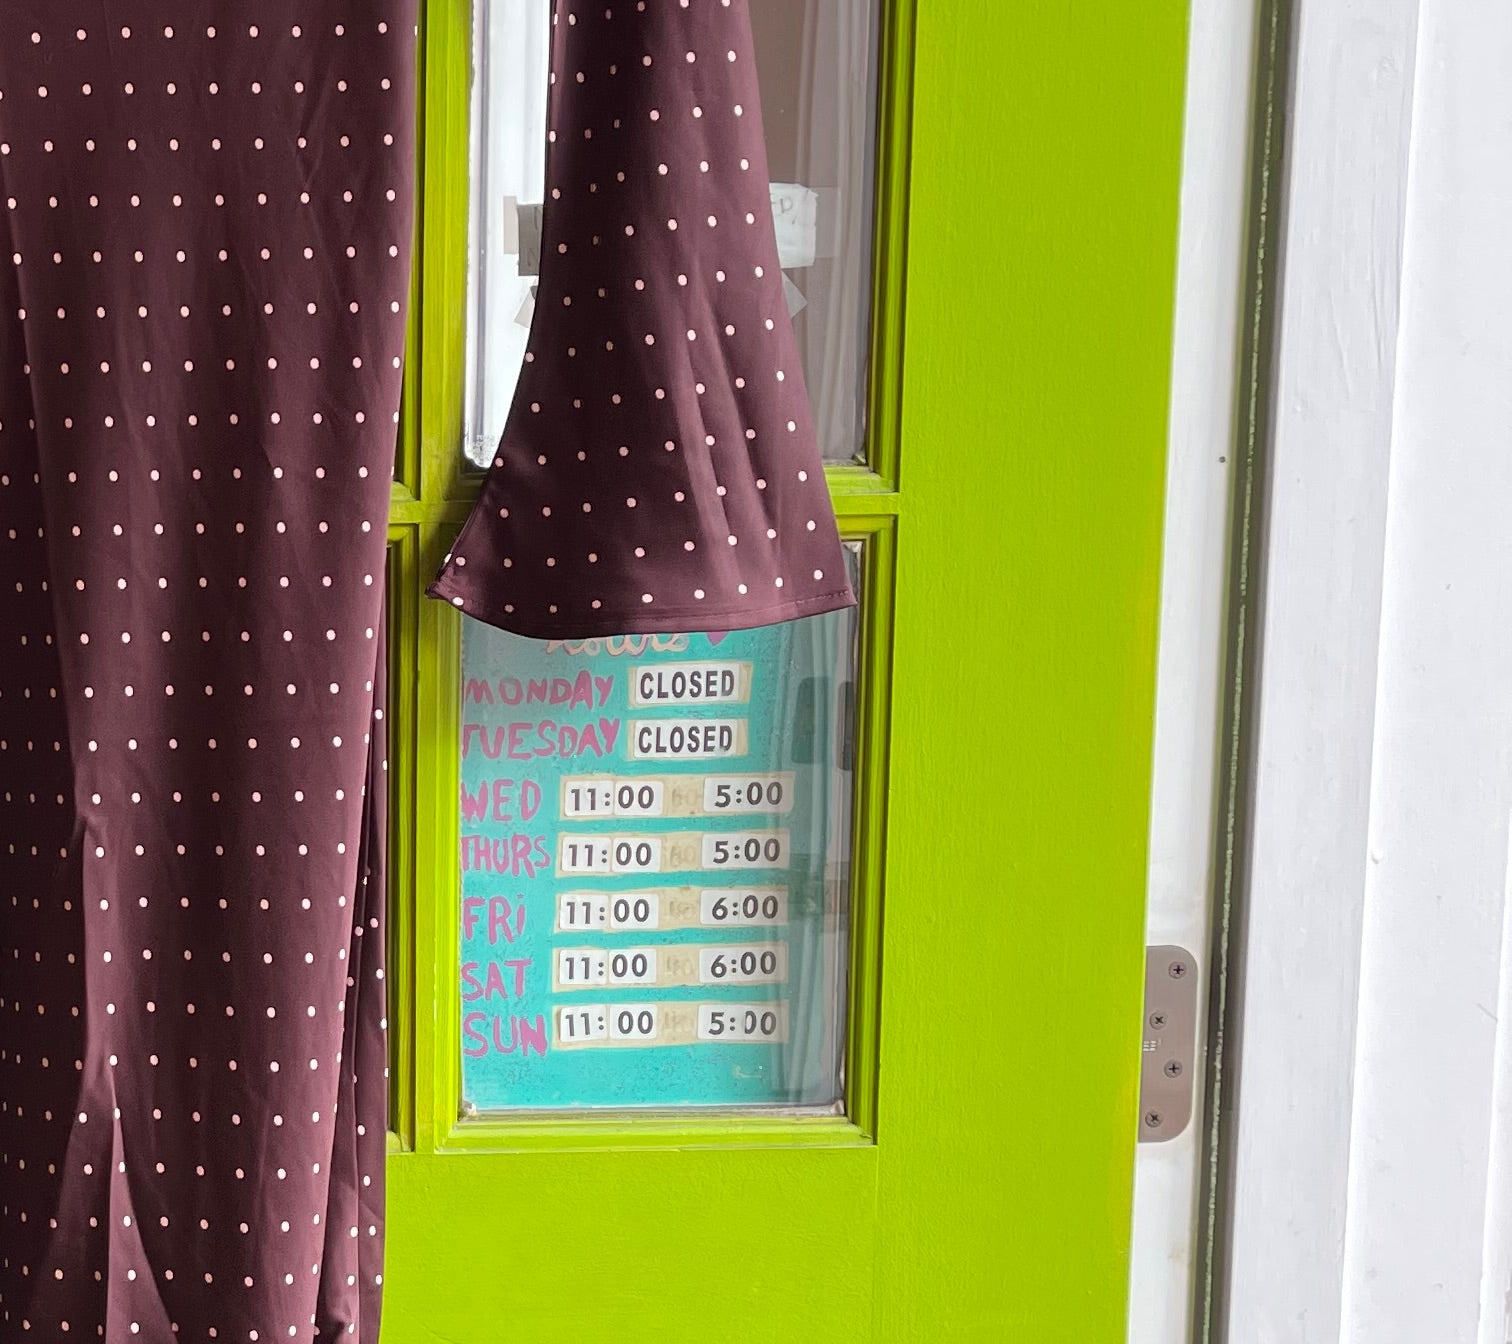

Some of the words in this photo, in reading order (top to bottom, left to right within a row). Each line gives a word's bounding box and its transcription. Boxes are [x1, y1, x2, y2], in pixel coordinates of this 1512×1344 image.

[464, 669, 615, 711] MONDAY
[640, 669, 736, 700] CLOSED
[462, 717, 621, 760] TUESDAY
[638, 725, 734, 754] CLOSED
[461, 778, 542, 823] WED
[570, 785, 655, 812] 11:00
[714, 781, 783, 808] 5:00
[461, 832, 551, 879] THURS
[568, 841, 653, 867] 11:00
[712, 838, 781, 864] 5:00
[565, 898, 650, 925] 11:00
[711, 894, 779, 921] 6:00
[461, 958, 533, 1001] SAT
[564, 953, 649, 980] 11:00
[710, 951, 777, 979] 6:00
[462, 1011, 548, 1058] SUN
[707, 1010, 778, 1036] 5:00
